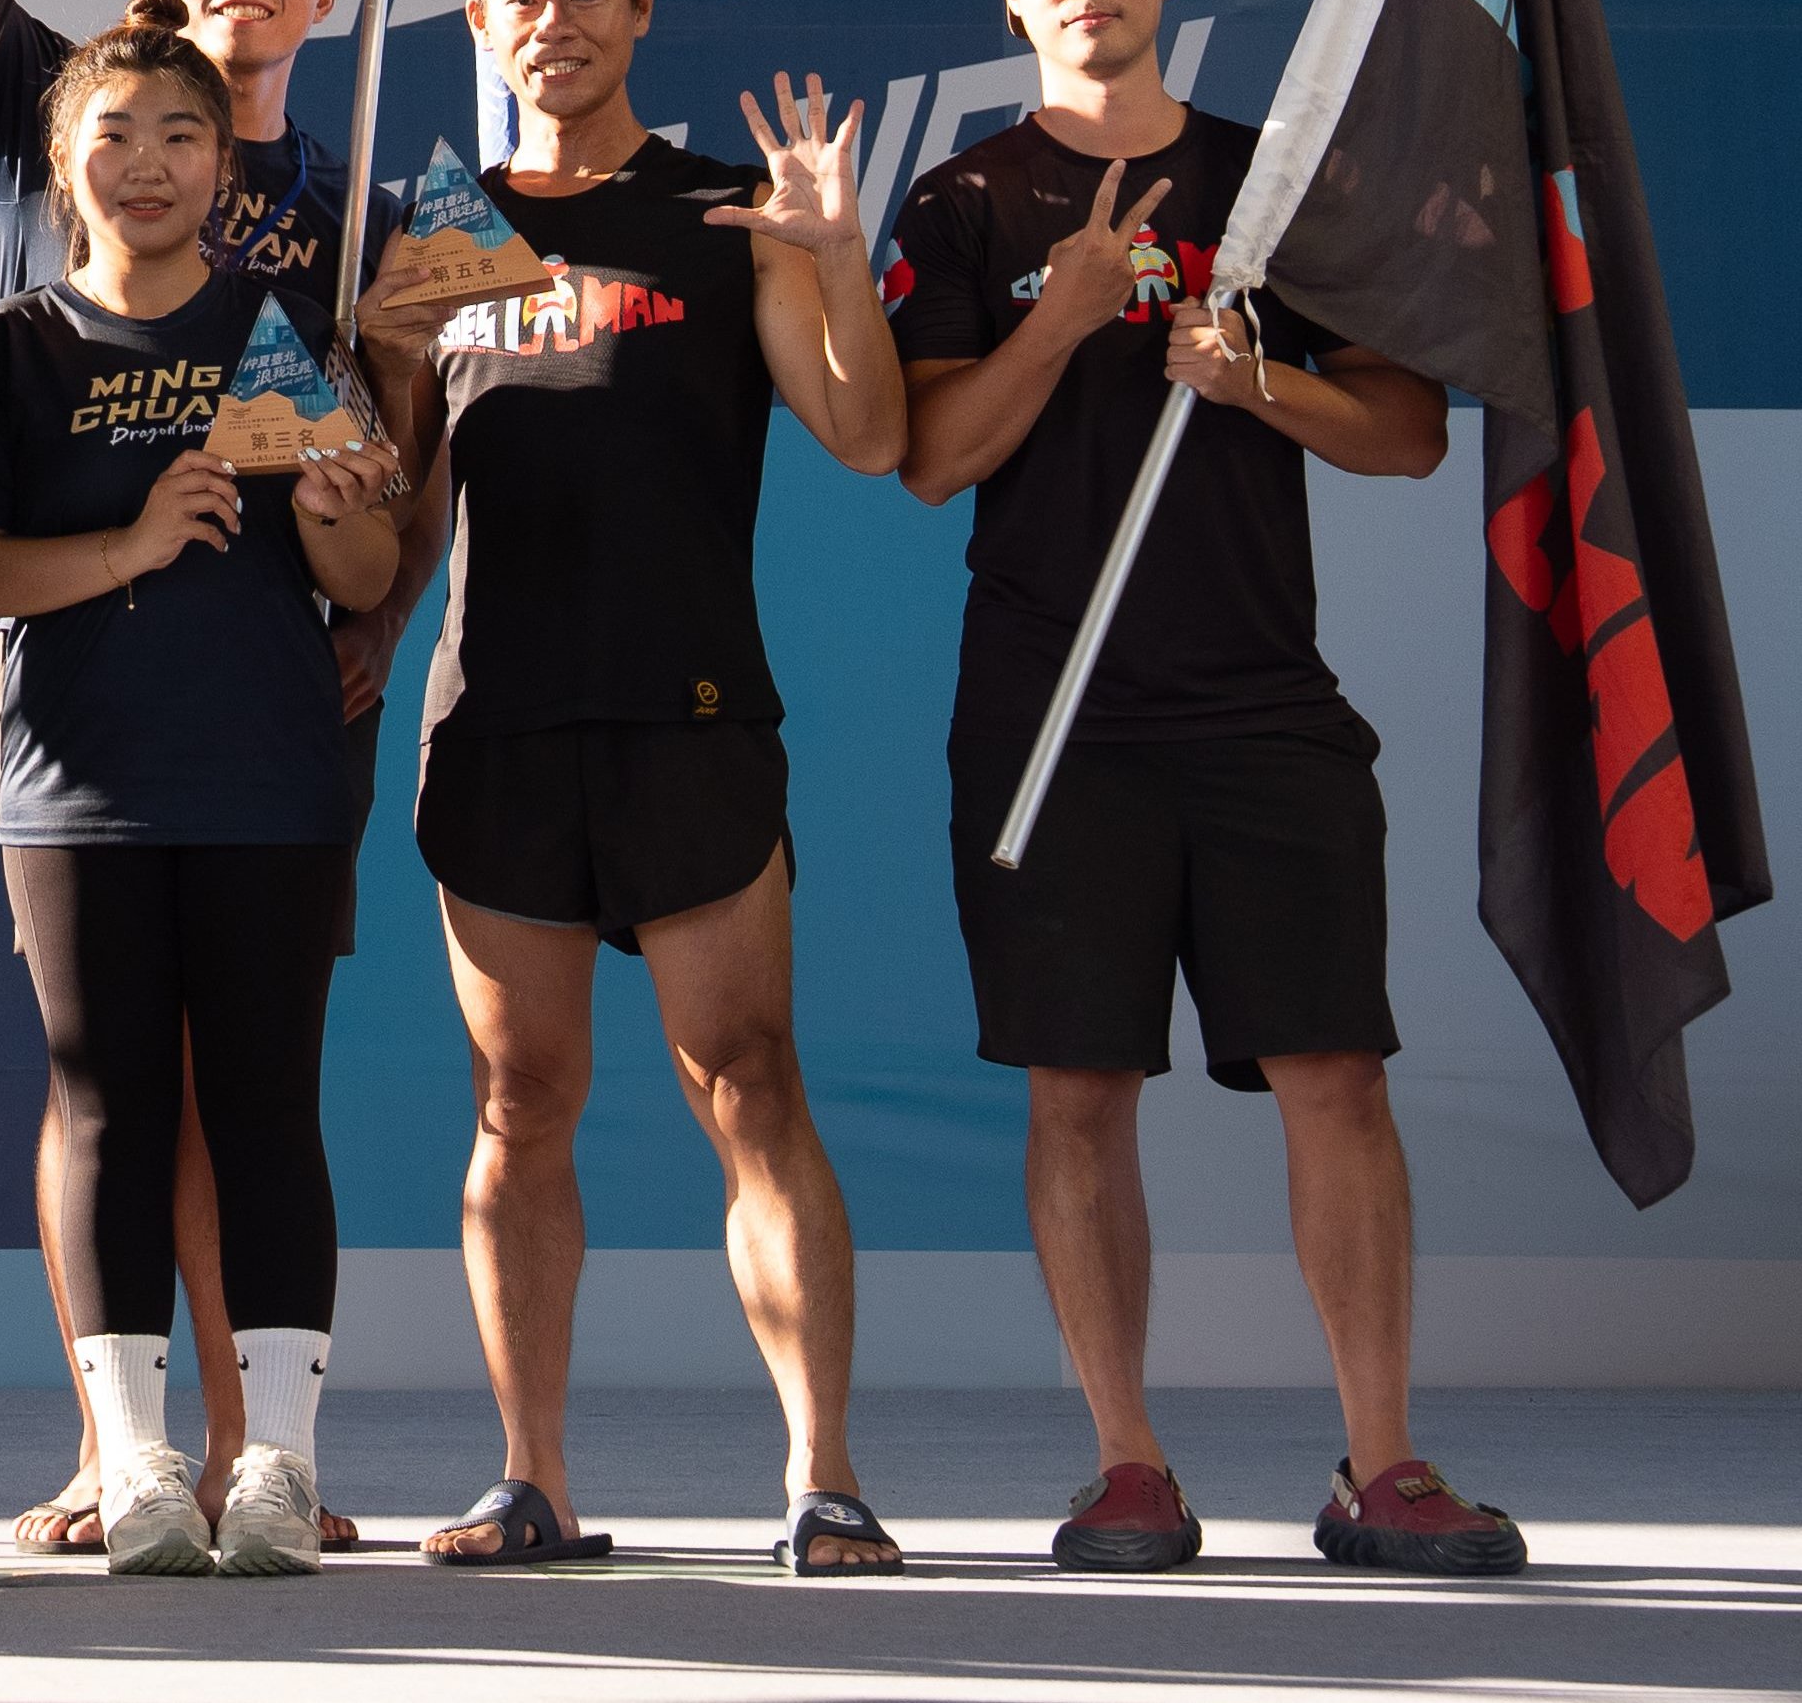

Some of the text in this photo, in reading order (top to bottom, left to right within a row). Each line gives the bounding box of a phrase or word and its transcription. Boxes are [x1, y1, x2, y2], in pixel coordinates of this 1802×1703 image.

[431, 257, 496, 284] 第五名
[579, 274, 684, 347] MAN
[70, 394, 228, 434] CHUA
[110, 426, 176, 446] Dragon
[250, 427, 316, 452] 第三名
